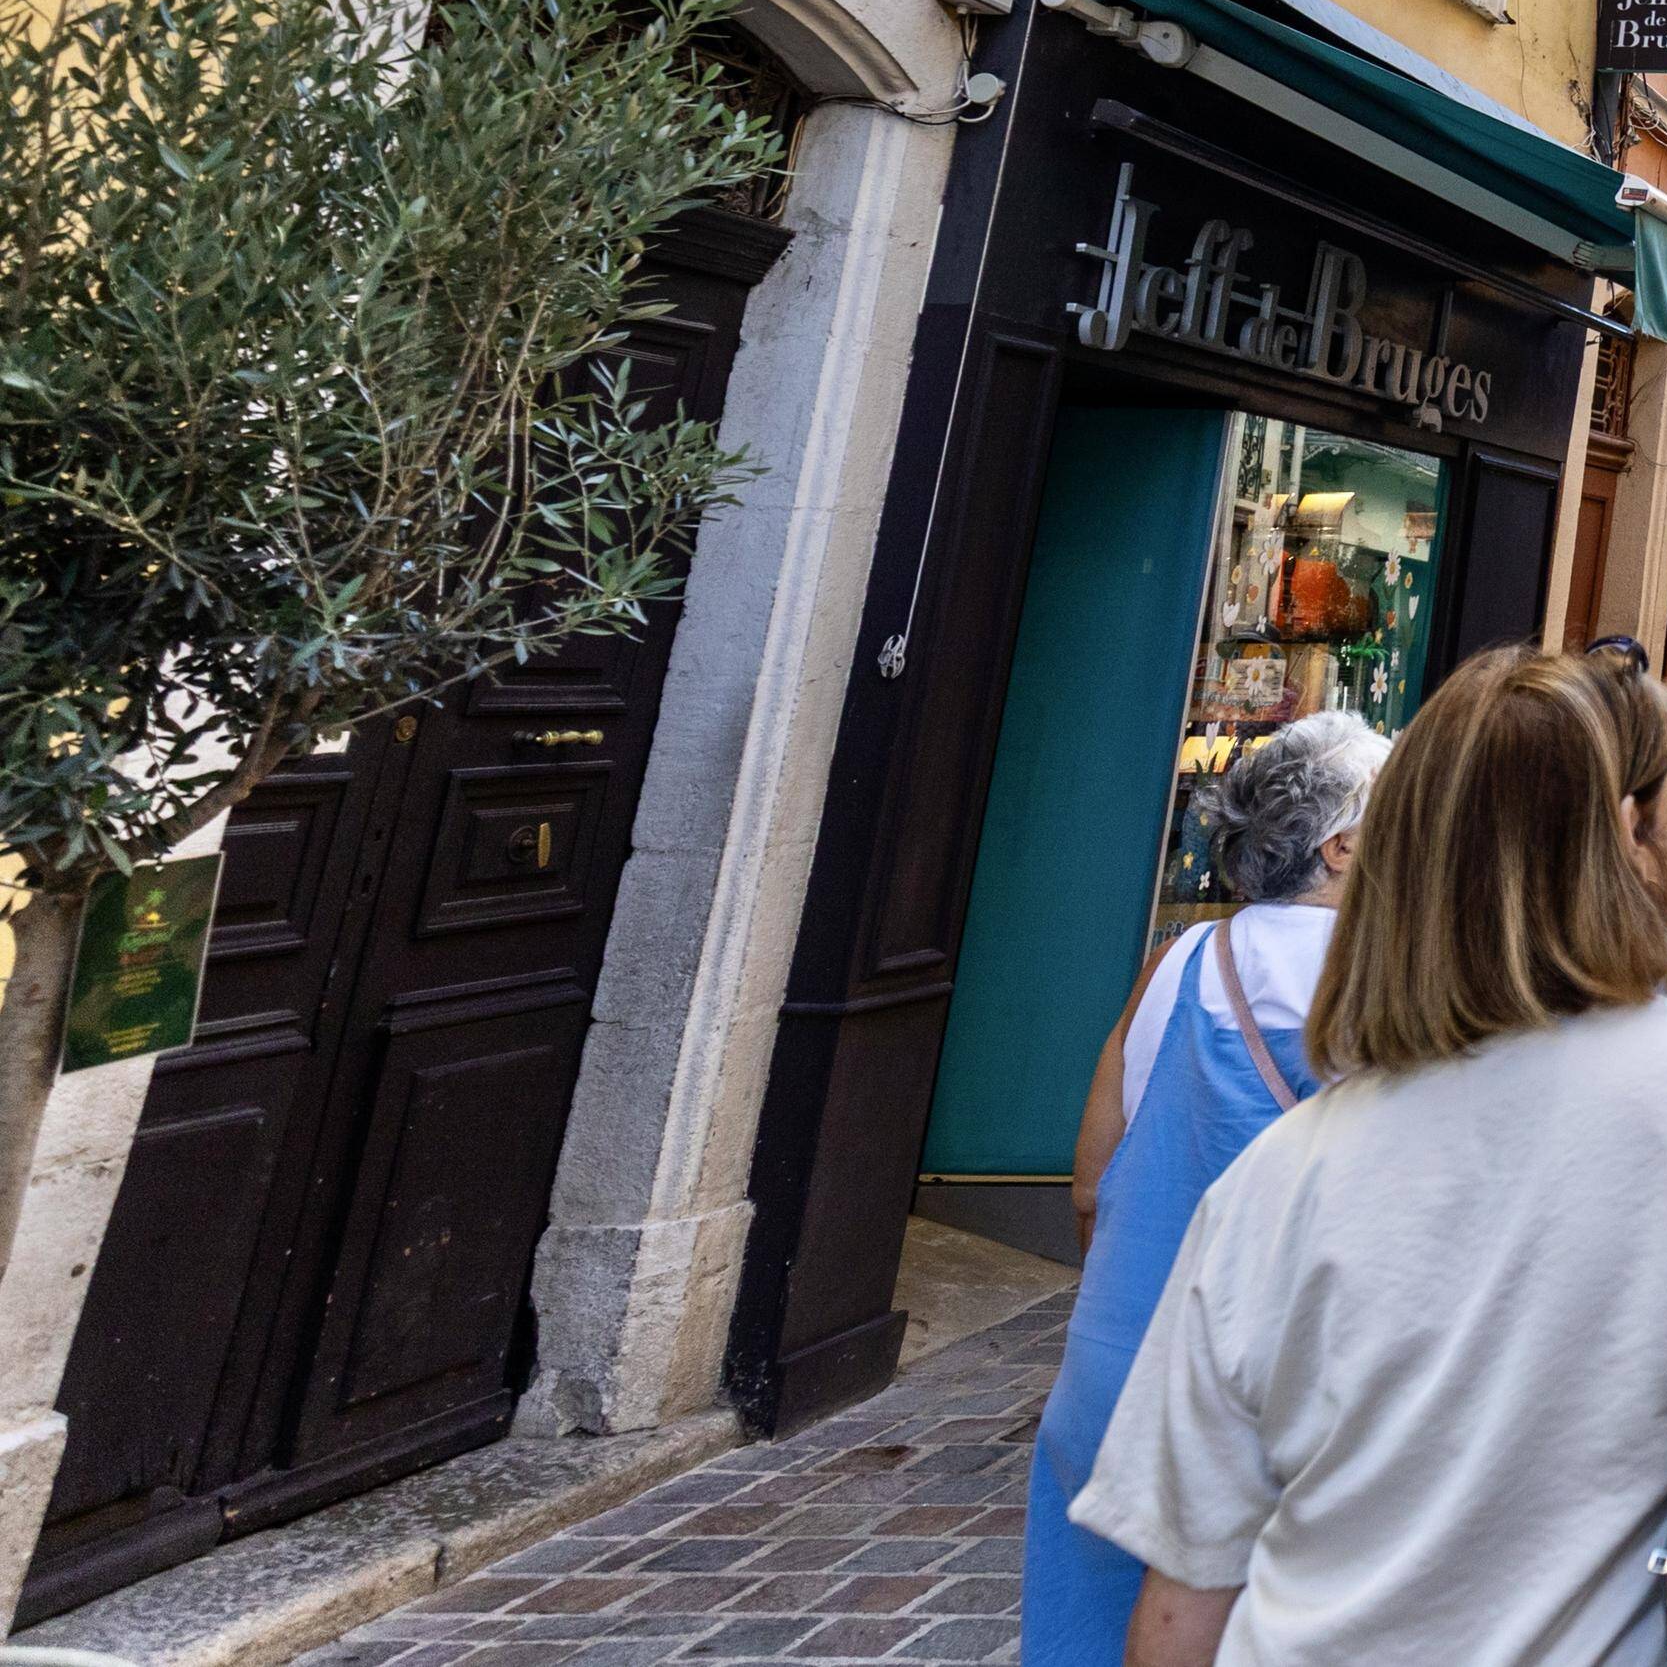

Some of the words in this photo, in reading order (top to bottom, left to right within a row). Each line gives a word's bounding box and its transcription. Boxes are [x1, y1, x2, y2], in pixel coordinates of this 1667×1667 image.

[1644, 10, 1667, 27] de
[1076, 194, 1255, 352] Jeff
[1239, 283, 1299, 369] de
[1303, 241, 1492, 433] Bruges
